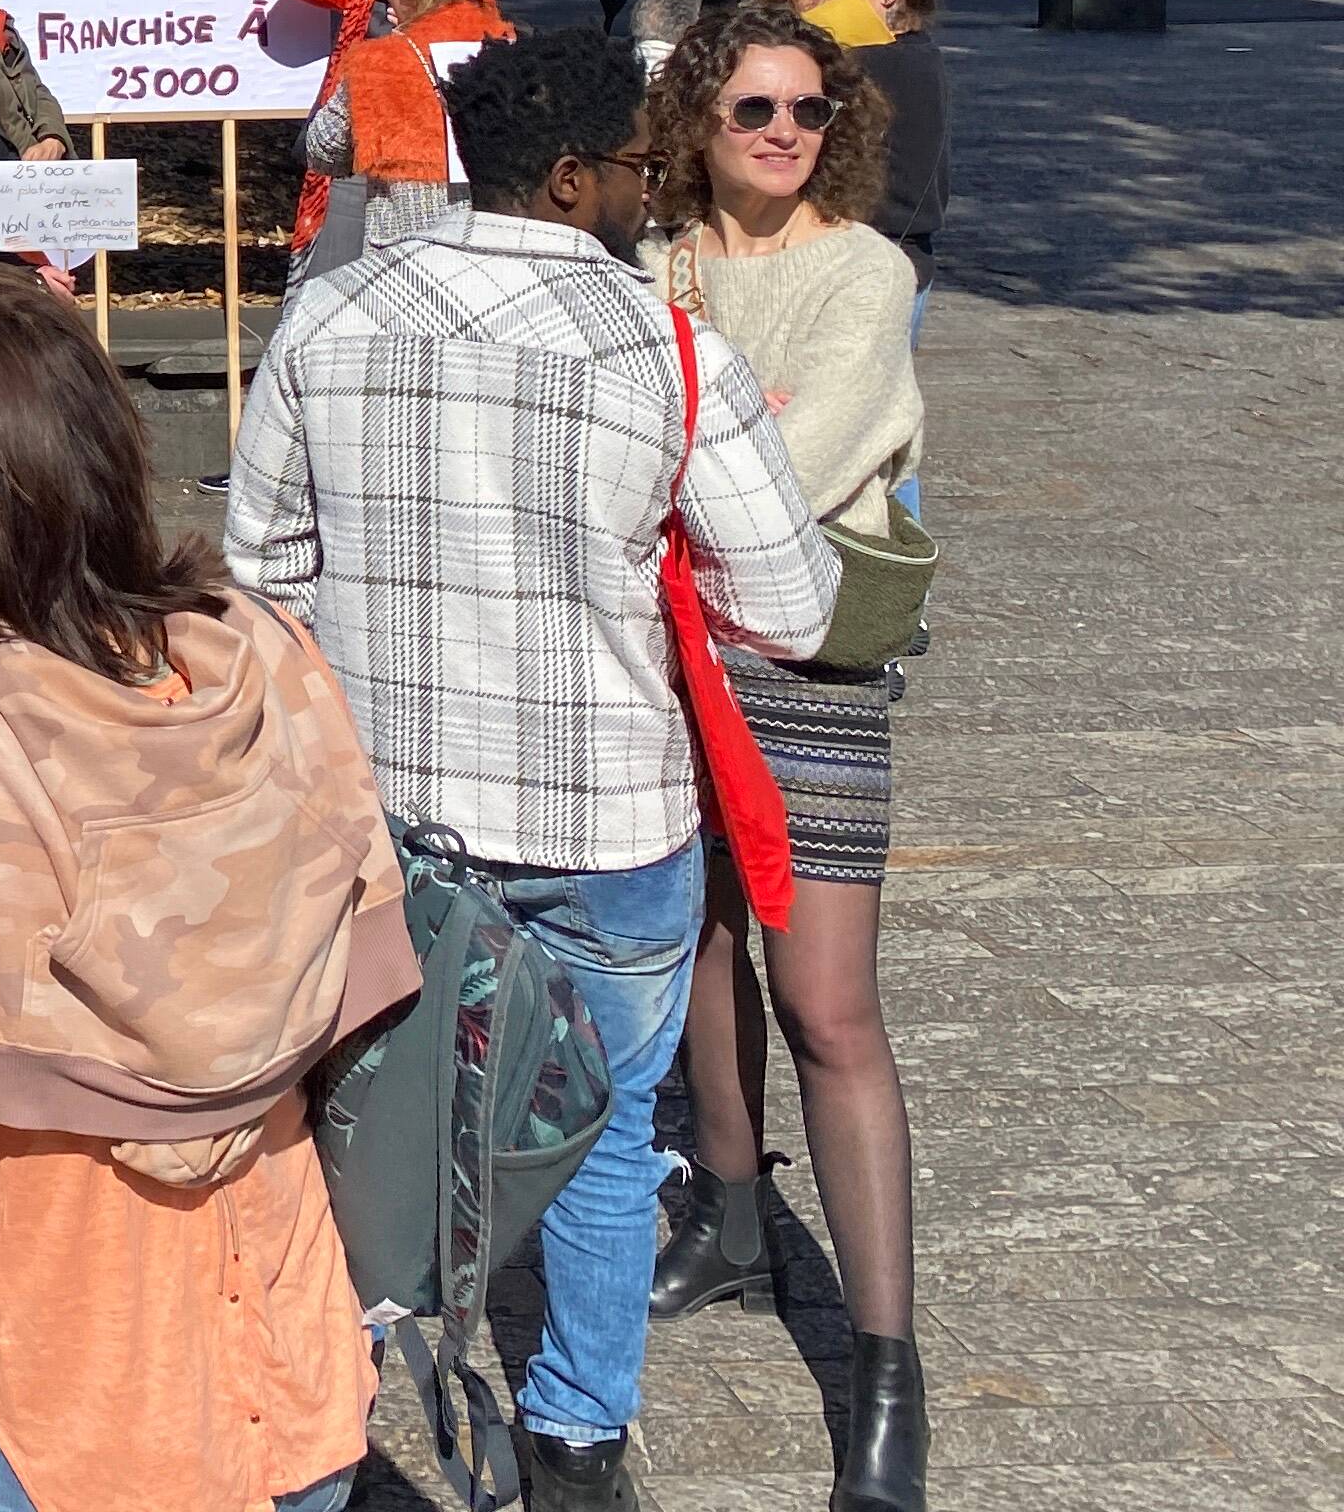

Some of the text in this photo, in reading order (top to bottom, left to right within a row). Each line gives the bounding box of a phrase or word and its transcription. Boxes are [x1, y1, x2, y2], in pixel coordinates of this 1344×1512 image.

[107, 64, 239, 100] 25000
[13, 164, 37, 179] 25
[44, 166, 74, 176] 000
[18, 183, 65, 200] plafond
[1, 213, 30, 235] NON
[52, 213, 63, 228] la
[39, 233, 58, 243] des
